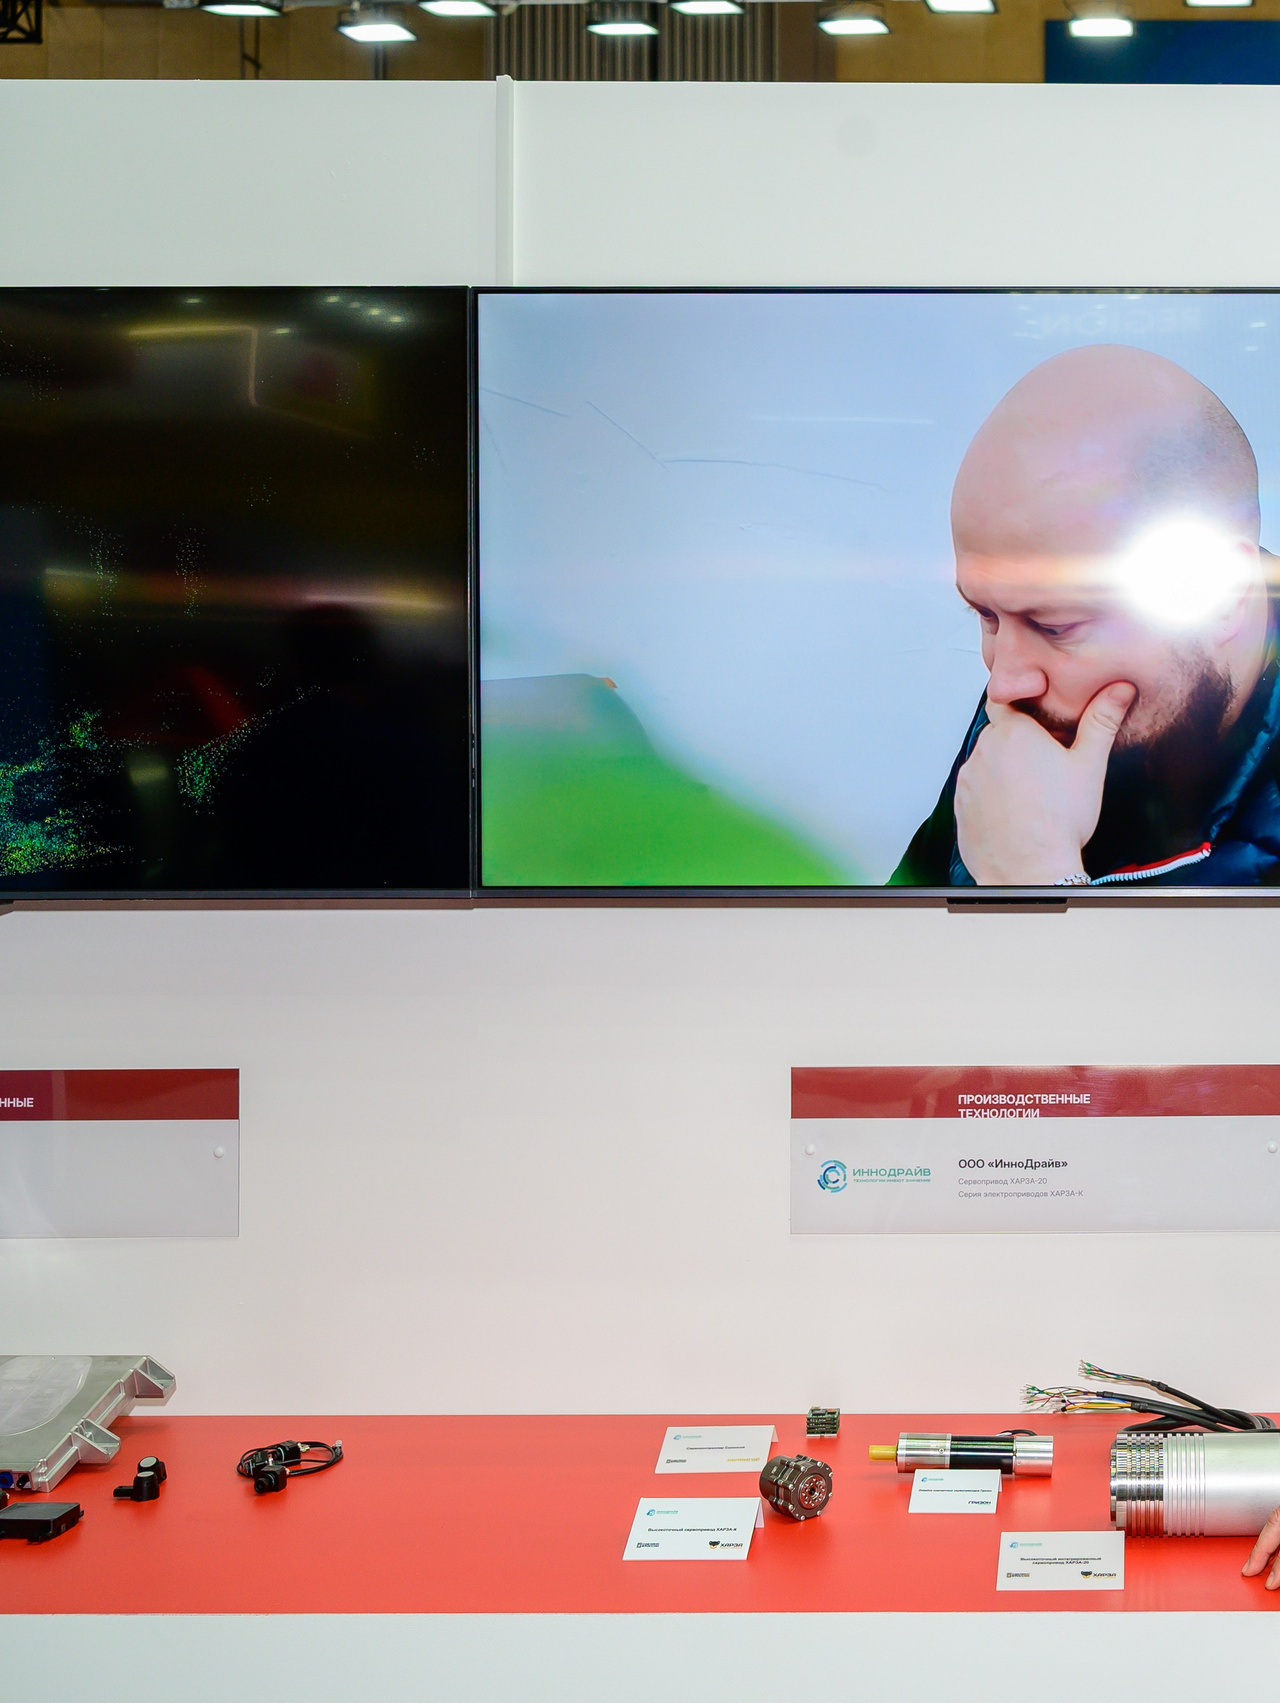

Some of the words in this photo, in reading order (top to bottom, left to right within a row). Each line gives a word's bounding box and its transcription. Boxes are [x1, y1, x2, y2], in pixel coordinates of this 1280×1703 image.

[0, 1097, 34, 1108] ННЫЕ
[958, 1094, 1091, 1106] ПРОИЗВОДСТВЕННЫЕ
[958, 1108, 1040, 1118] ТЕХНОЛОГИИ
[958, 1159, 985, 1169] ООО
[987, 1158, 1068, 1170] «ИнноДрайв»
[852, 1166, 931, 1178] ИННОДРАЙВ
[958, 1178, 1009, 1186] Сервопривод
[983, 1191, 1048, 1199] электроприводов
